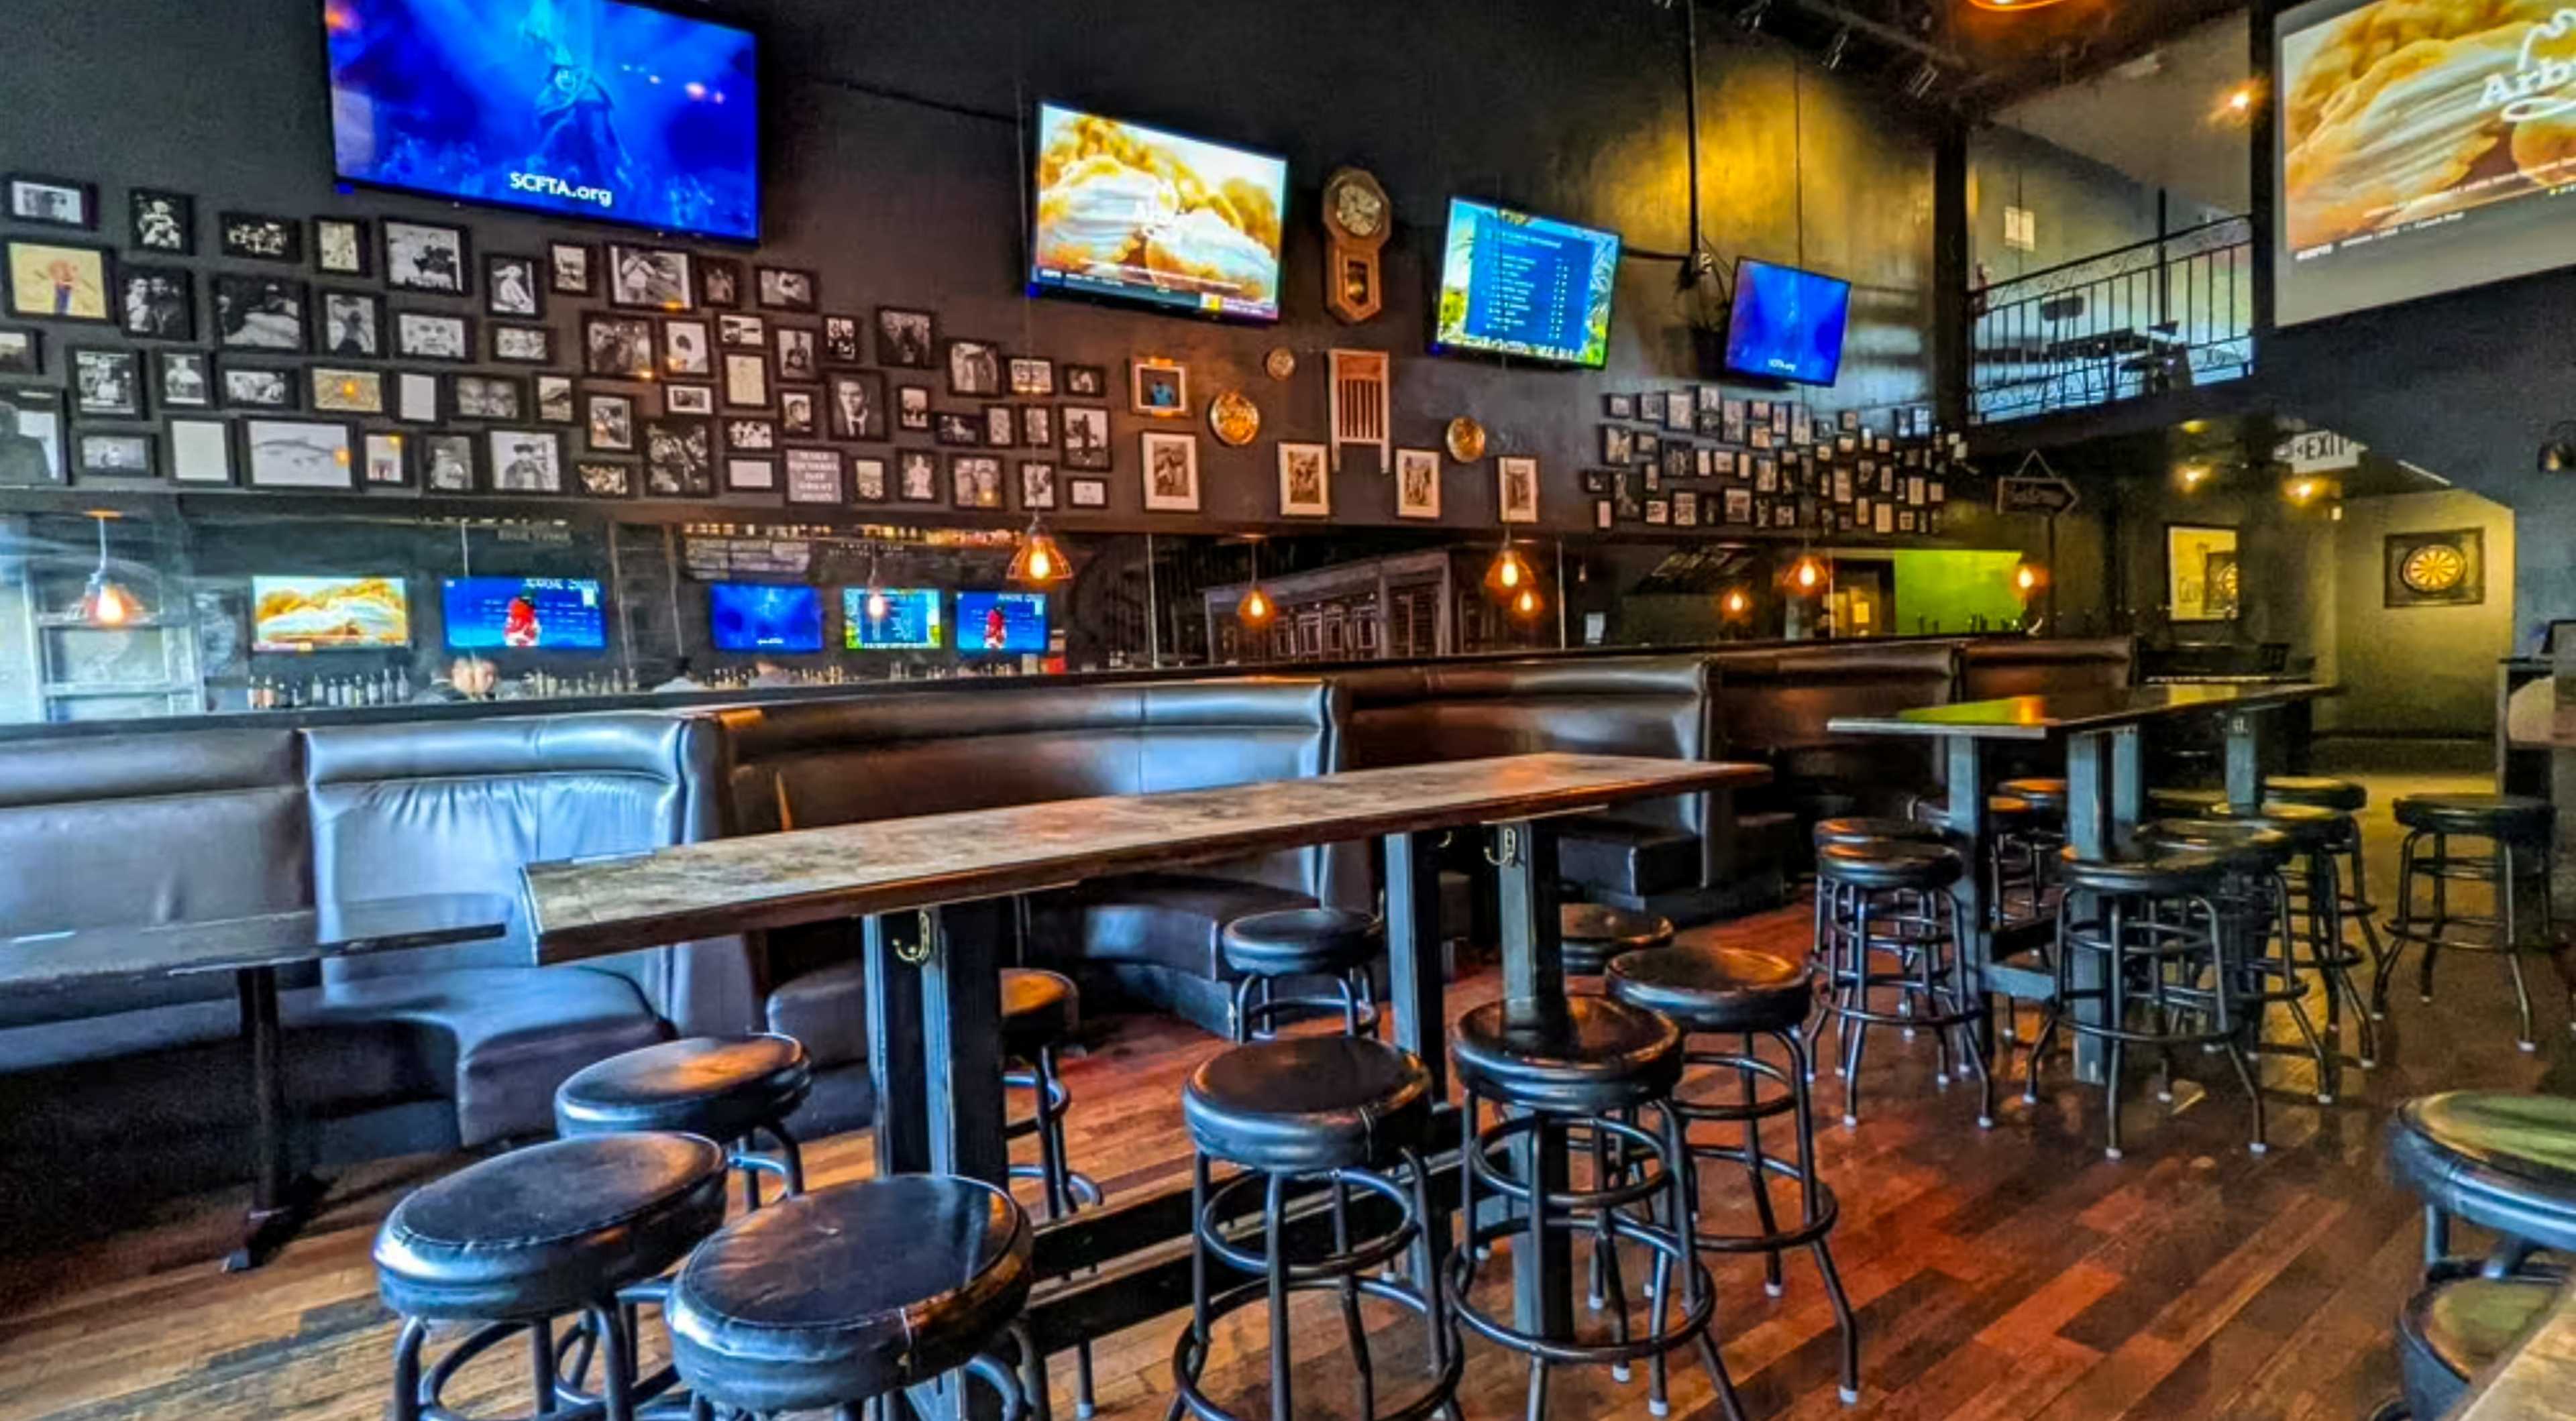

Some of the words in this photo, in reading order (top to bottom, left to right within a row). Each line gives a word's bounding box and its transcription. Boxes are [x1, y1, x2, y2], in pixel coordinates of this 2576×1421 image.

[2476, 57, 2576, 110] Arb
[510, 171, 612, 207] SCFTA.org
[2305, 433, 2350, 460] EXIT
